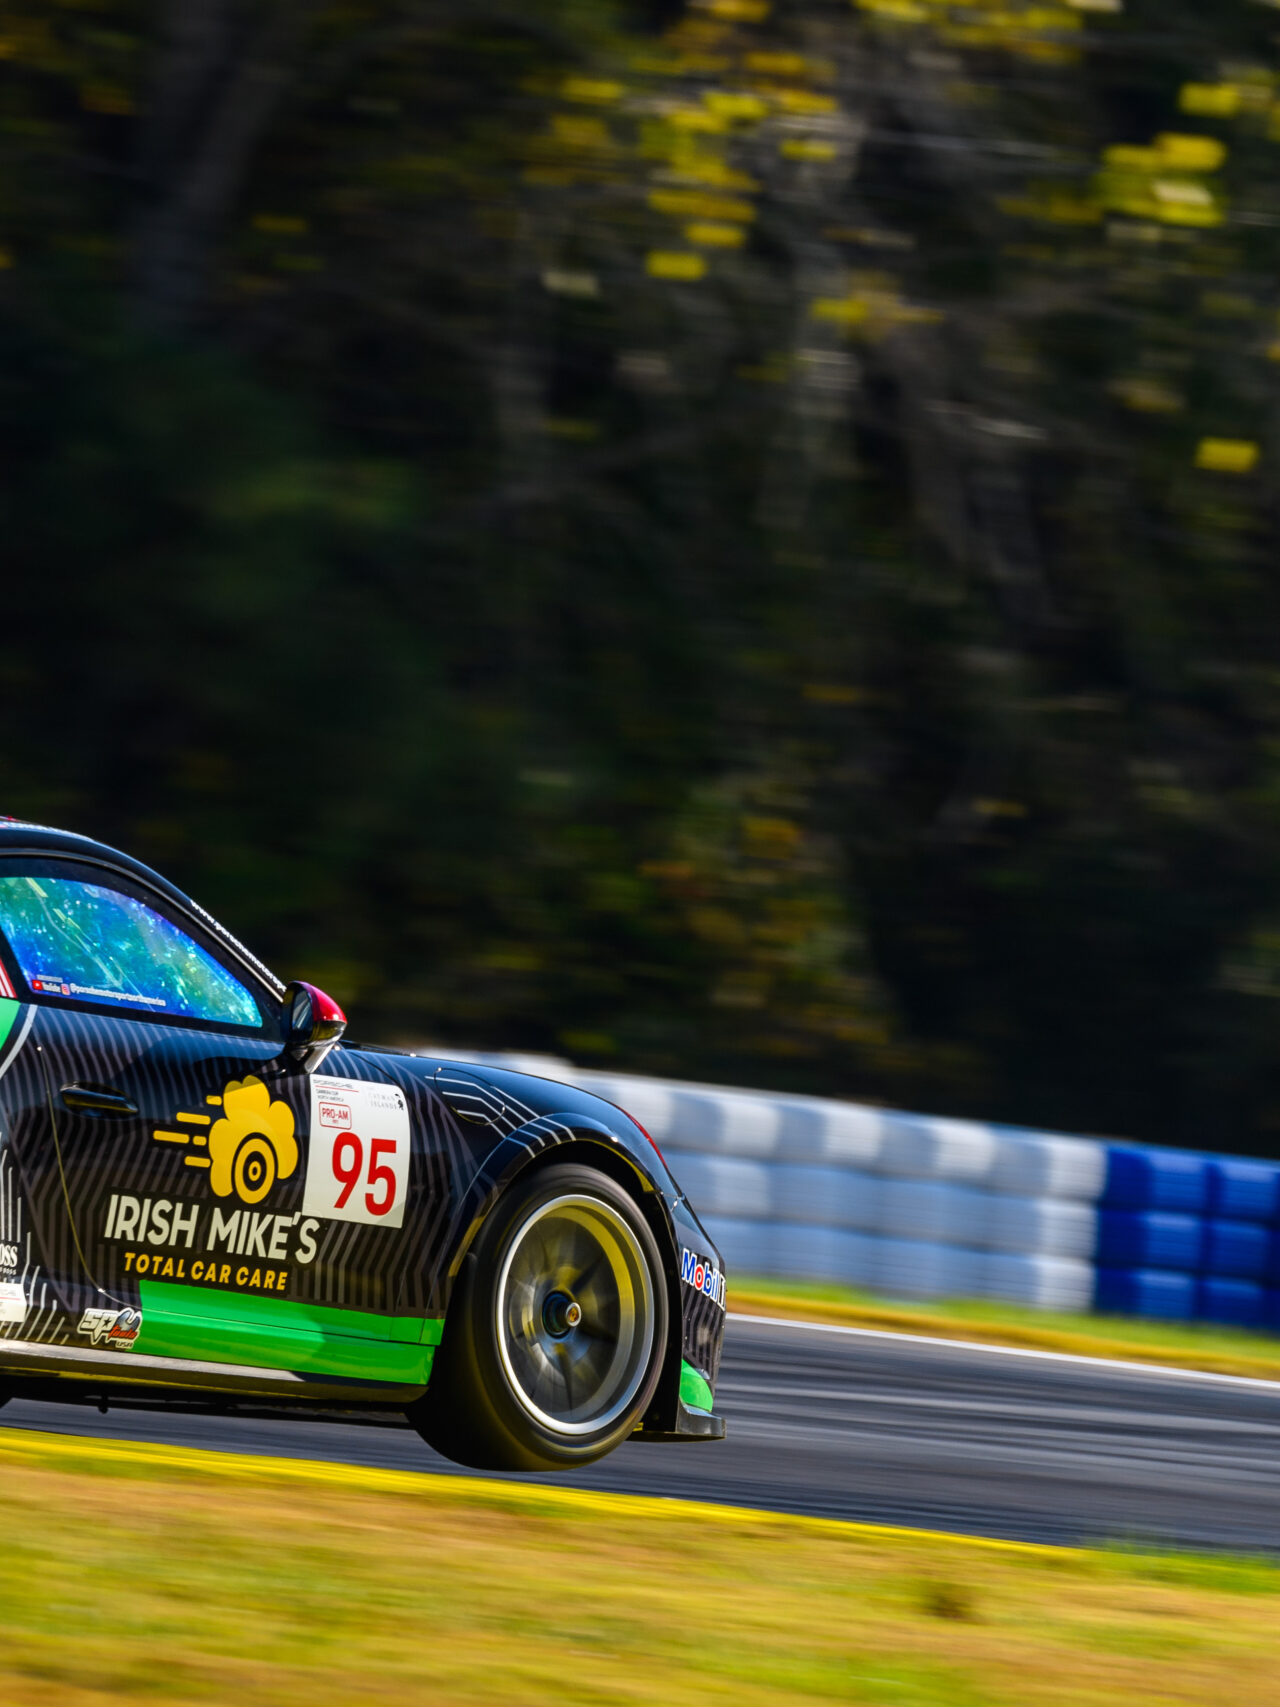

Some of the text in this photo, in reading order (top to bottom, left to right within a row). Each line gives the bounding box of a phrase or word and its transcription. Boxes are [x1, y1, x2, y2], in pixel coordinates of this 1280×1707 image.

[322, 1107, 349, 1120] PRO-AM
[332, 1132, 396, 1216] 95
[104, 1194, 320, 1264] IRISH MIKE'S
[124, 1252, 288, 1290] TOTAL CAR CARE
[681, 1248, 719, 1303] Mobil
